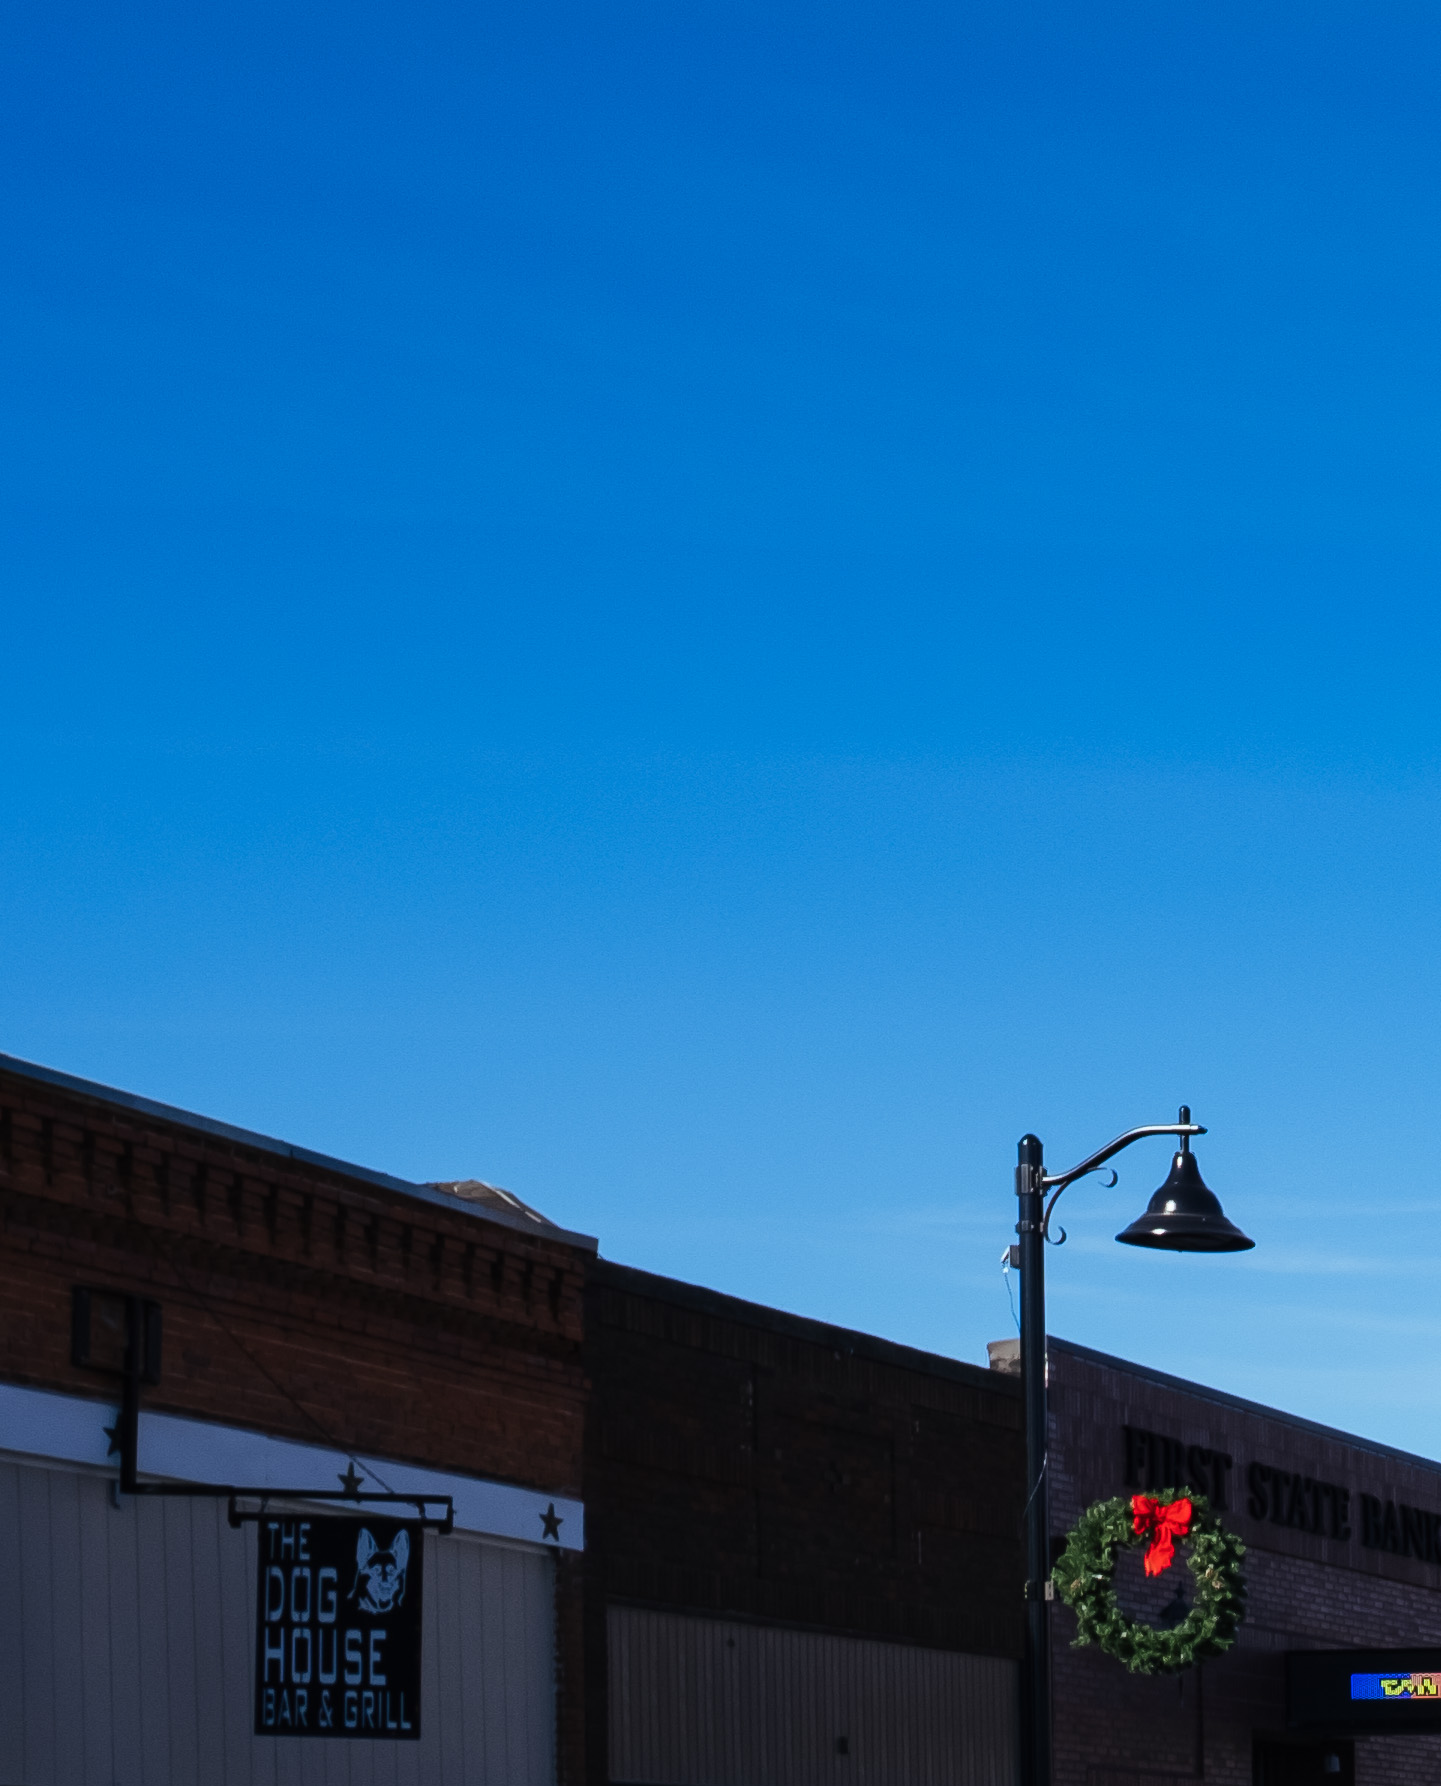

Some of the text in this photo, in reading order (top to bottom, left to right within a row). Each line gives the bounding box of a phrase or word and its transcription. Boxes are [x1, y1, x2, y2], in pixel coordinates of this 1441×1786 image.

[1123, 1425, 1232, 1511] FIRST
[1249, 1461, 1351, 1541] STATE
[267, 1522, 311, 1561] THE
[265, 1566, 338, 1623] DOG
[264, 1627, 387, 1686] HOUSE
[262, 1688, 412, 1729] BAR & GRILL
